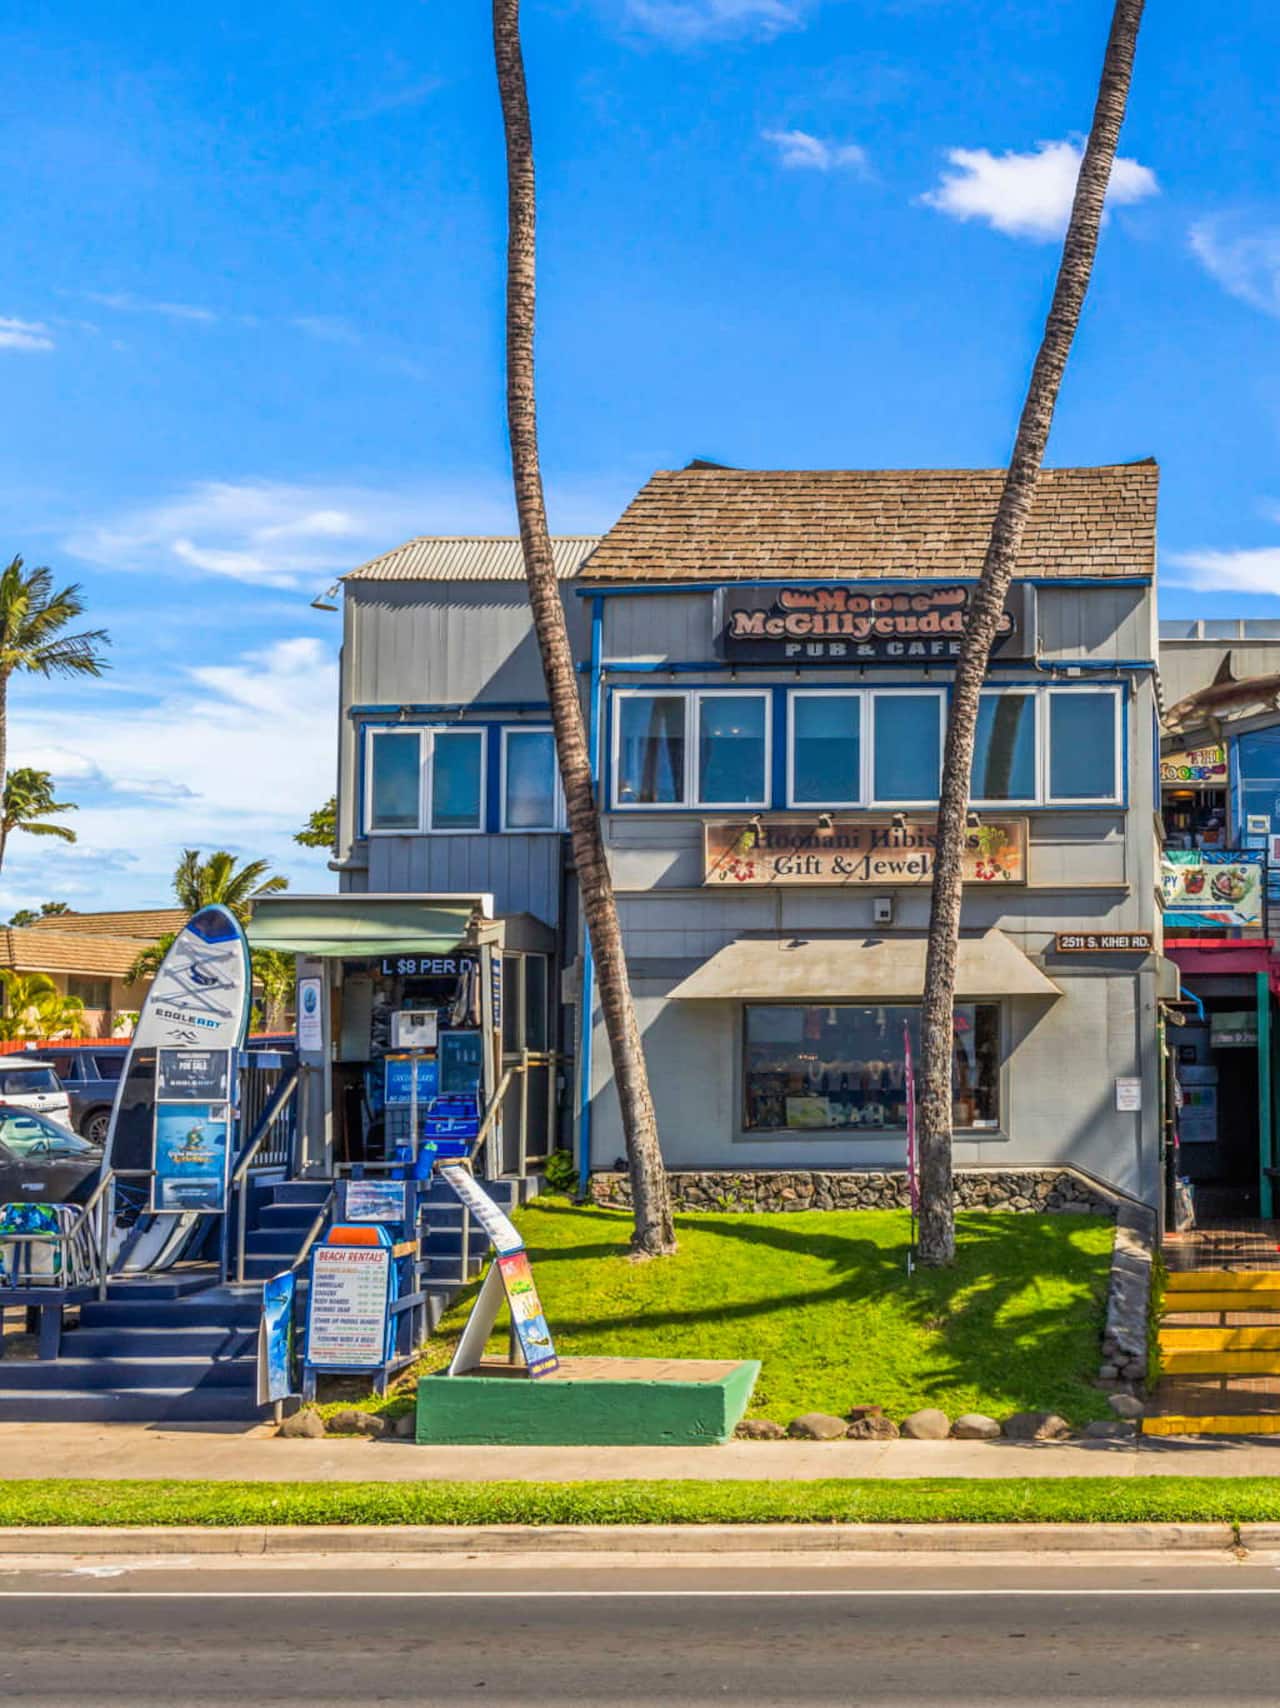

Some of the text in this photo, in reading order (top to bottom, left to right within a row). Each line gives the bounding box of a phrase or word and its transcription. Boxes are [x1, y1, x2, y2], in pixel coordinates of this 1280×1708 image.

[816, 590, 930, 613] Moose
[733, 611, 1012, 637] McGillycudds
[785, 641, 848, 657] PUB
[857, 642, 876, 656] &
[871, 829, 980, 849] Hibiss
[773, 854, 937, 880] Gift & Jewel
[1061, 935, 1151, 948] 2511 S. KIHEI RD.
[382, 960, 393, 974] L
[397, 958, 417, 975] $8
[420, 959, 456, 974] PER
[320, 1251, 384, 1263] BEACH RENTALS
